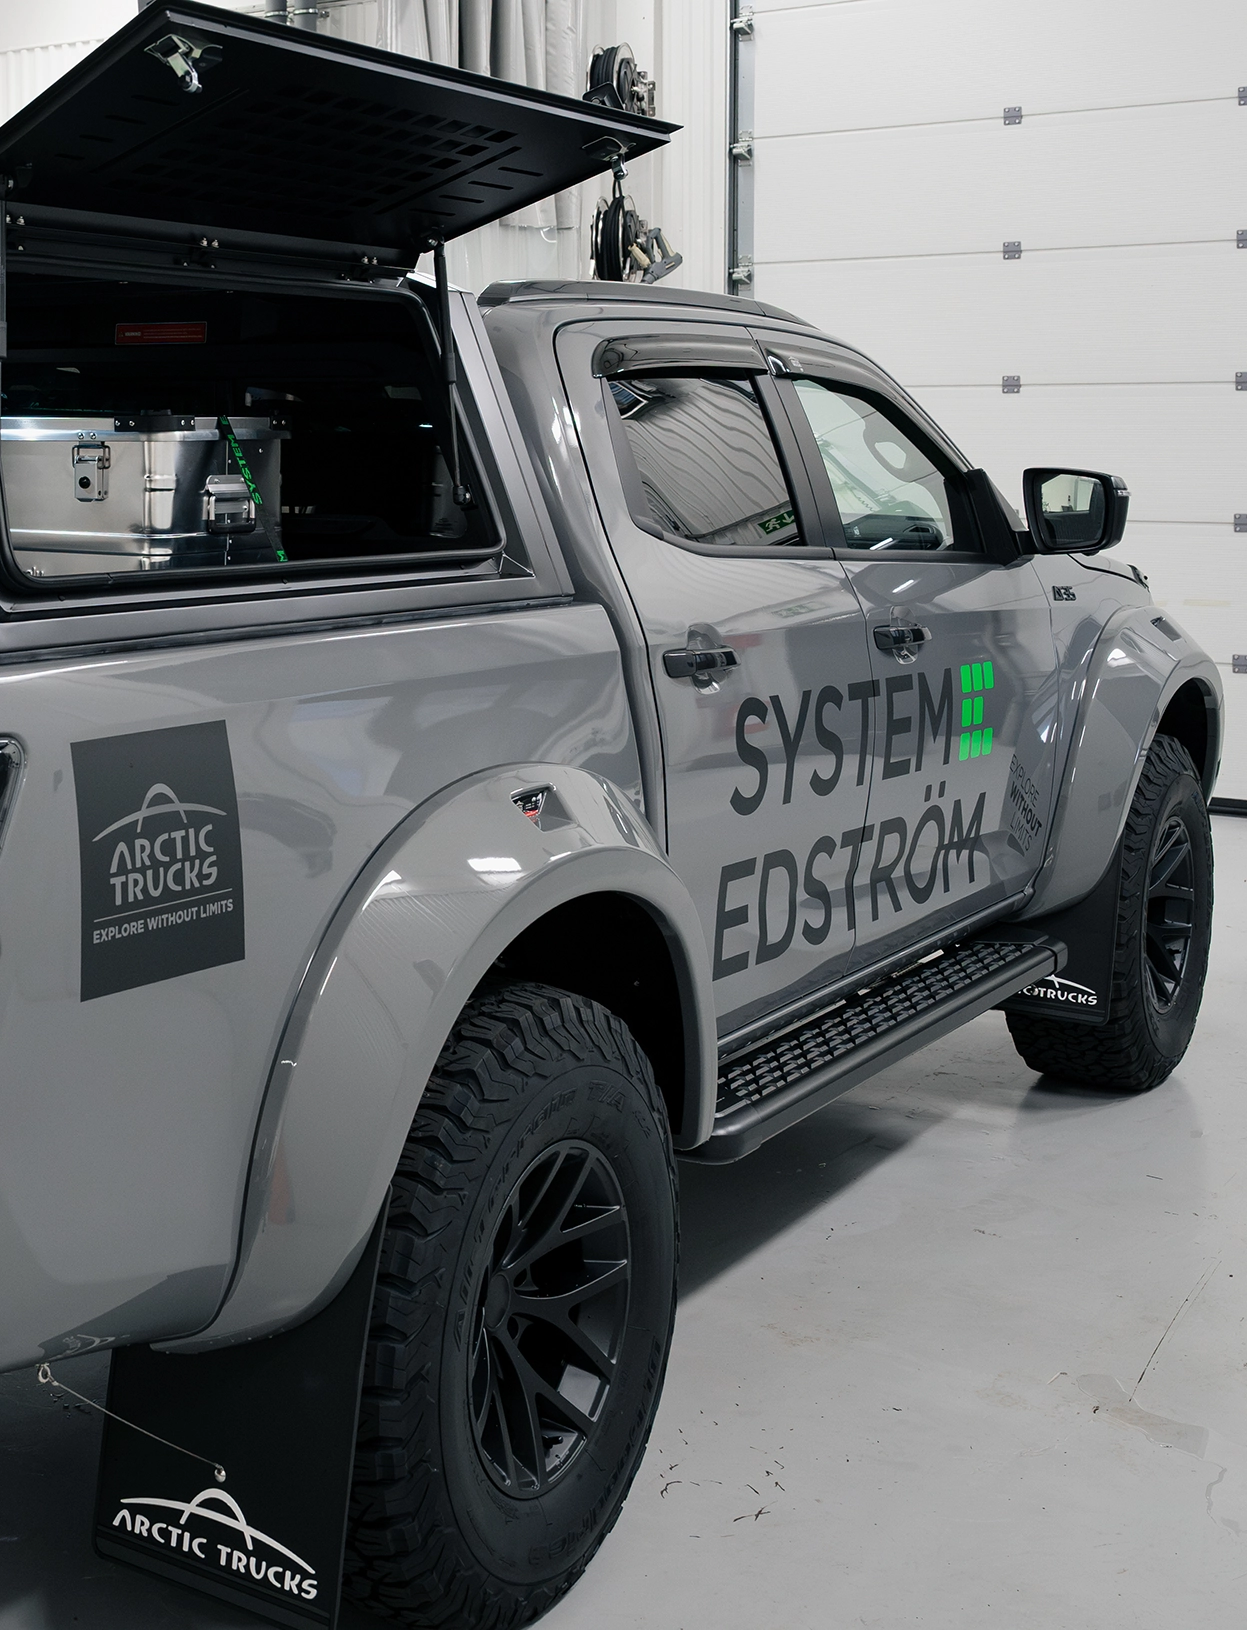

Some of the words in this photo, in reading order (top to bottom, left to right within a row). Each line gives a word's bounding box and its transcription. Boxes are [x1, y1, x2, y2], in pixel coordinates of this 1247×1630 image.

[227, 434, 263, 505] SYSTEM
[729, 667, 952, 816] SYSTEM
[1009, 753, 1040, 808] EXPLORE
[1010, 780, 1043, 837] WITHOUT
[1010, 811, 1033, 852] LIMITS
[109, 823, 215, 874] ARCTIC
[109, 855, 218, 906] TRUCKS
[712, 780, 987, 982] EDSTRÖM
[92, 919, 145, 944] EXPLORE
[147, 906, 198, 931] WITHOUT
[200, 898, 234, 919] LIMITS
[1039, 987, 1098, 1006] TRUCKS
[112, 1508, 207, 1559] ARCTIC
[216, 1543, 318, 1600] TRUCKS
